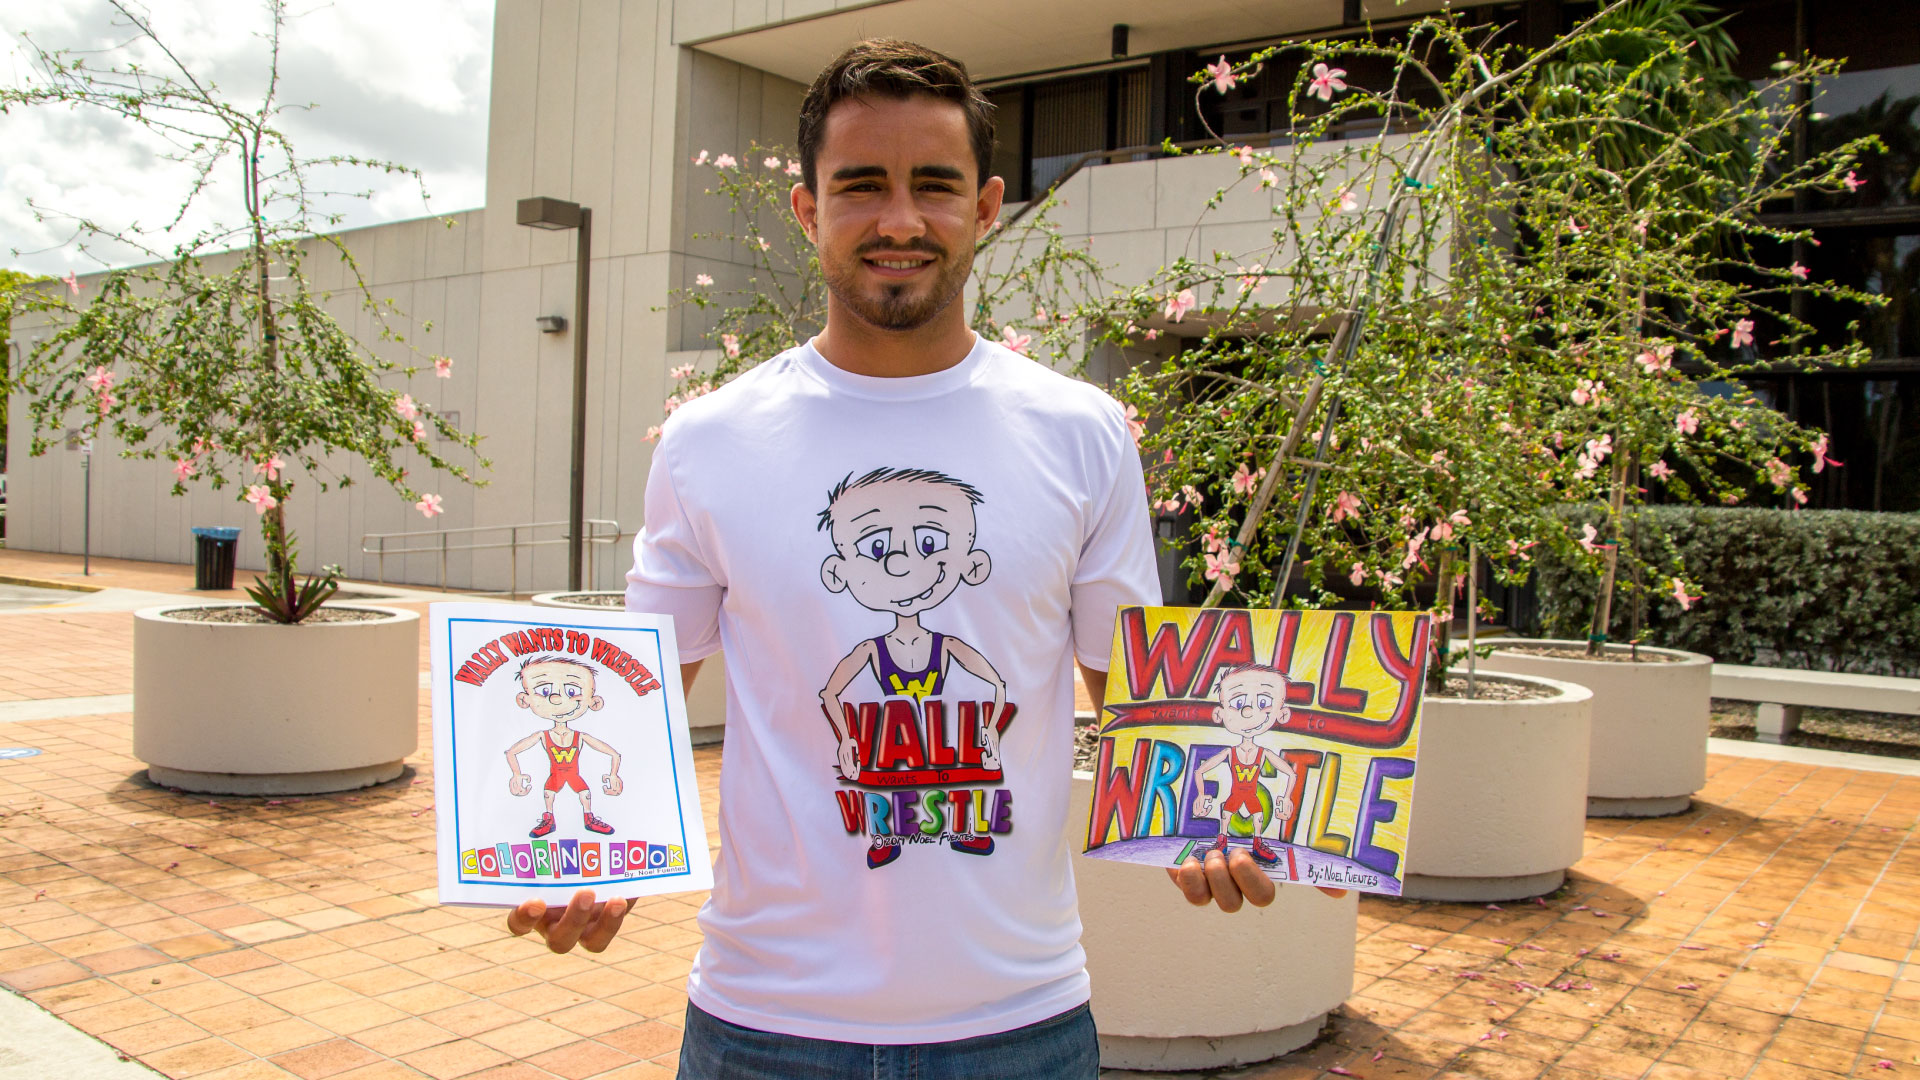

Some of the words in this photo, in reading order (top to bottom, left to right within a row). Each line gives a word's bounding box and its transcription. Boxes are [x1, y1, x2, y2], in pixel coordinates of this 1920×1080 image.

[454, 639, 510, 687] WALLY
[500, 627, 564, 660] WANTS
[566, 631, 590, 655] TO
[592, 637, 662, 697] WRESTLE
[1120, 606, 1432, 748] WALLY
[1151, 704, 1200, 719] wants
[1307, 714, 1327, 730] to
[550, 746, 577, 764] W
[1234, 763, 1260, 783] W
[835, 789, 1013, 835] WRESTLE
[462, 844, 600, 874] COLORING
[610, 846, 683, 869] BOOK
